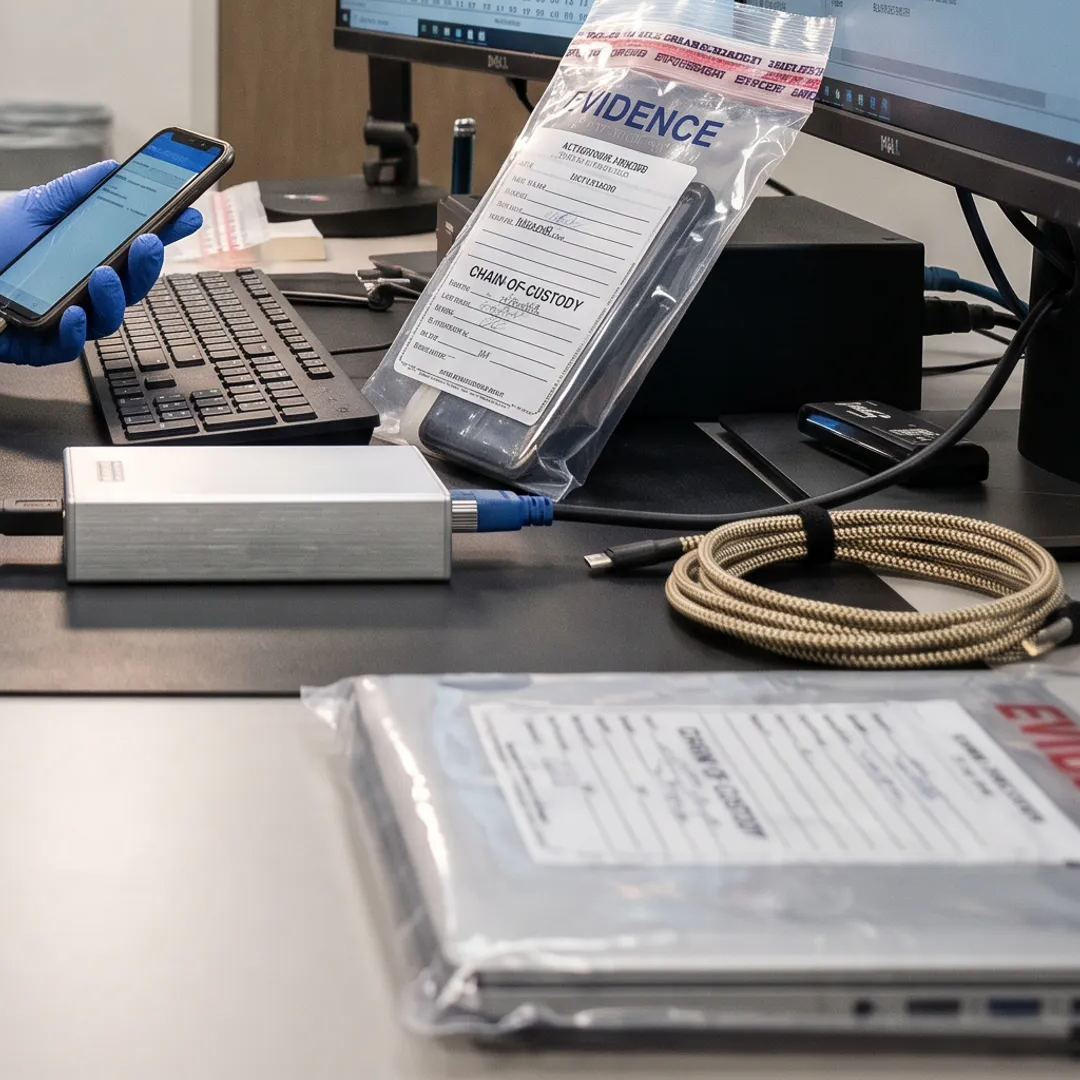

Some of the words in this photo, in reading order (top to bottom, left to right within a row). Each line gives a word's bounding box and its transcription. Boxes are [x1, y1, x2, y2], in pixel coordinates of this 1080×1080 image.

[469, 265, 507, 287] CHAIN
[506, 278, 526, 292] OF
[525, 284, 584, 312] CUSTODY
[994, 702, 1080, 789] EVID
